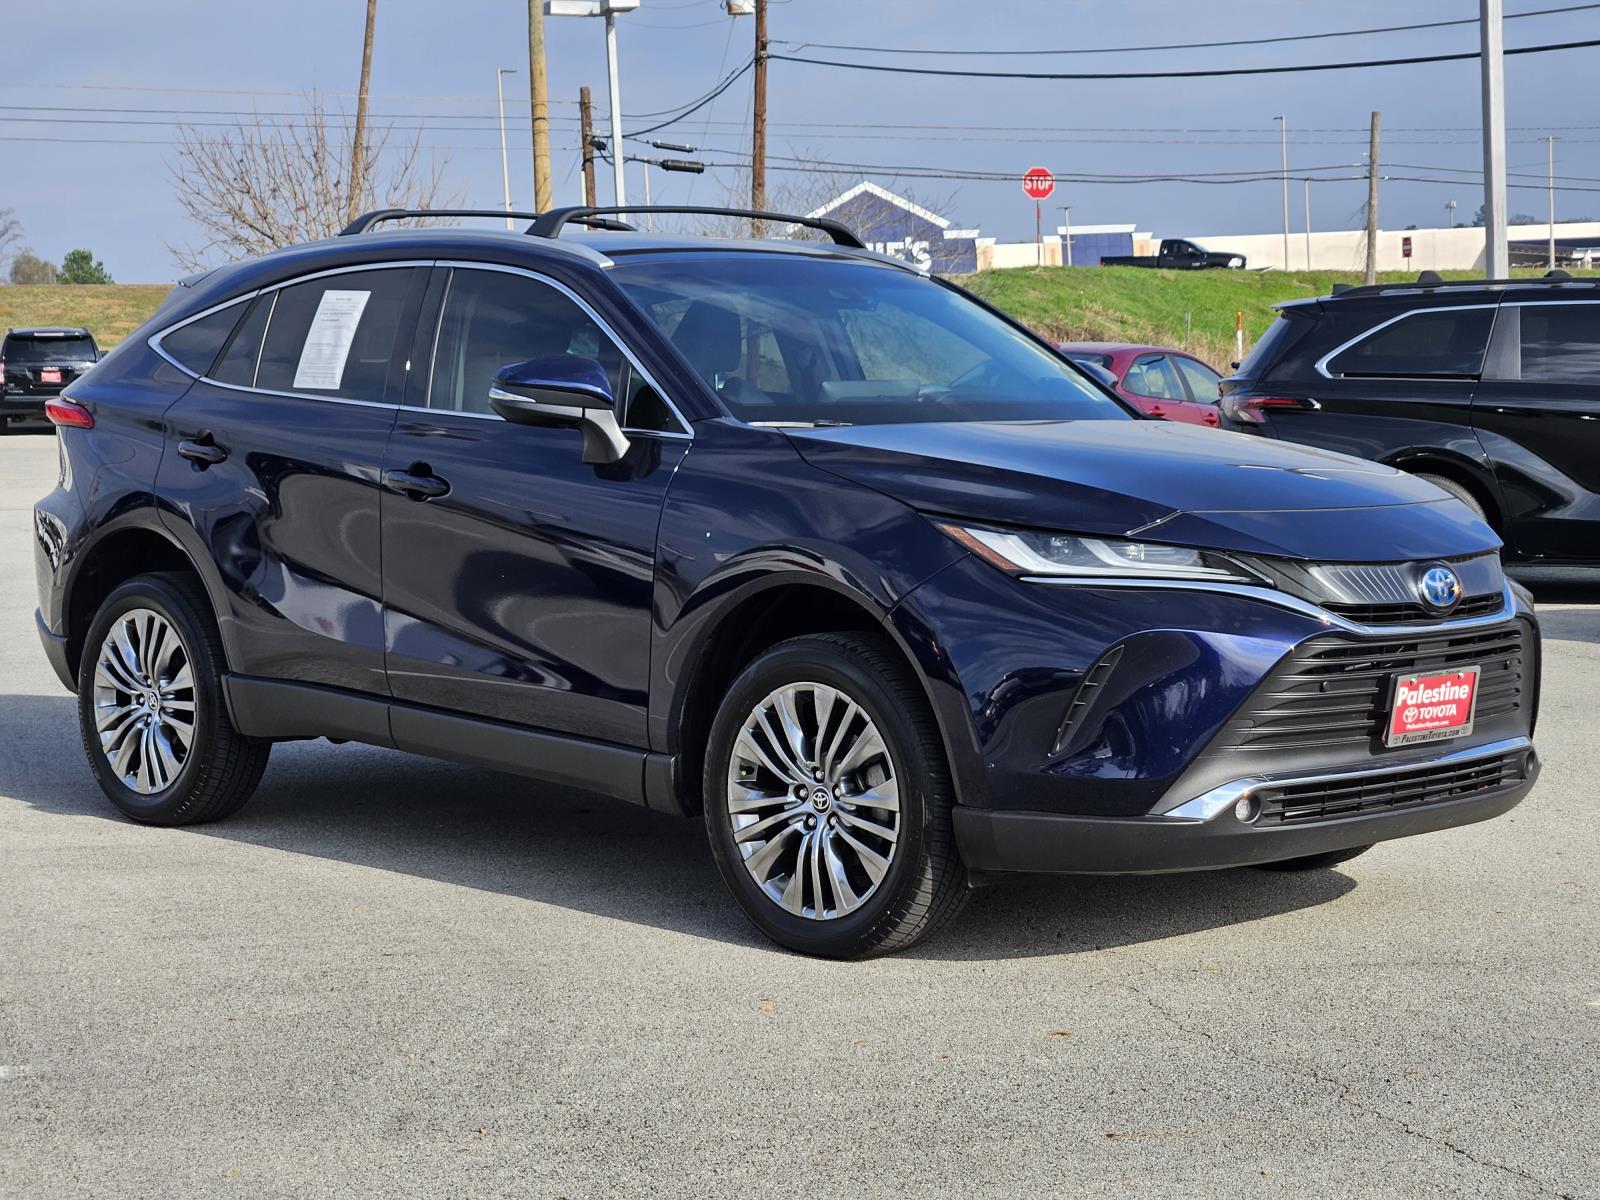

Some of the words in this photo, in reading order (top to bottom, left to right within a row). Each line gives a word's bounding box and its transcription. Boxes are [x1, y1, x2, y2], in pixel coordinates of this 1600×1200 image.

[1025, 176, 1052, 190] STOP
[1397, 682, 1469, 706] Palestine
[1419, 704, 1456, 719] TOYOTA
